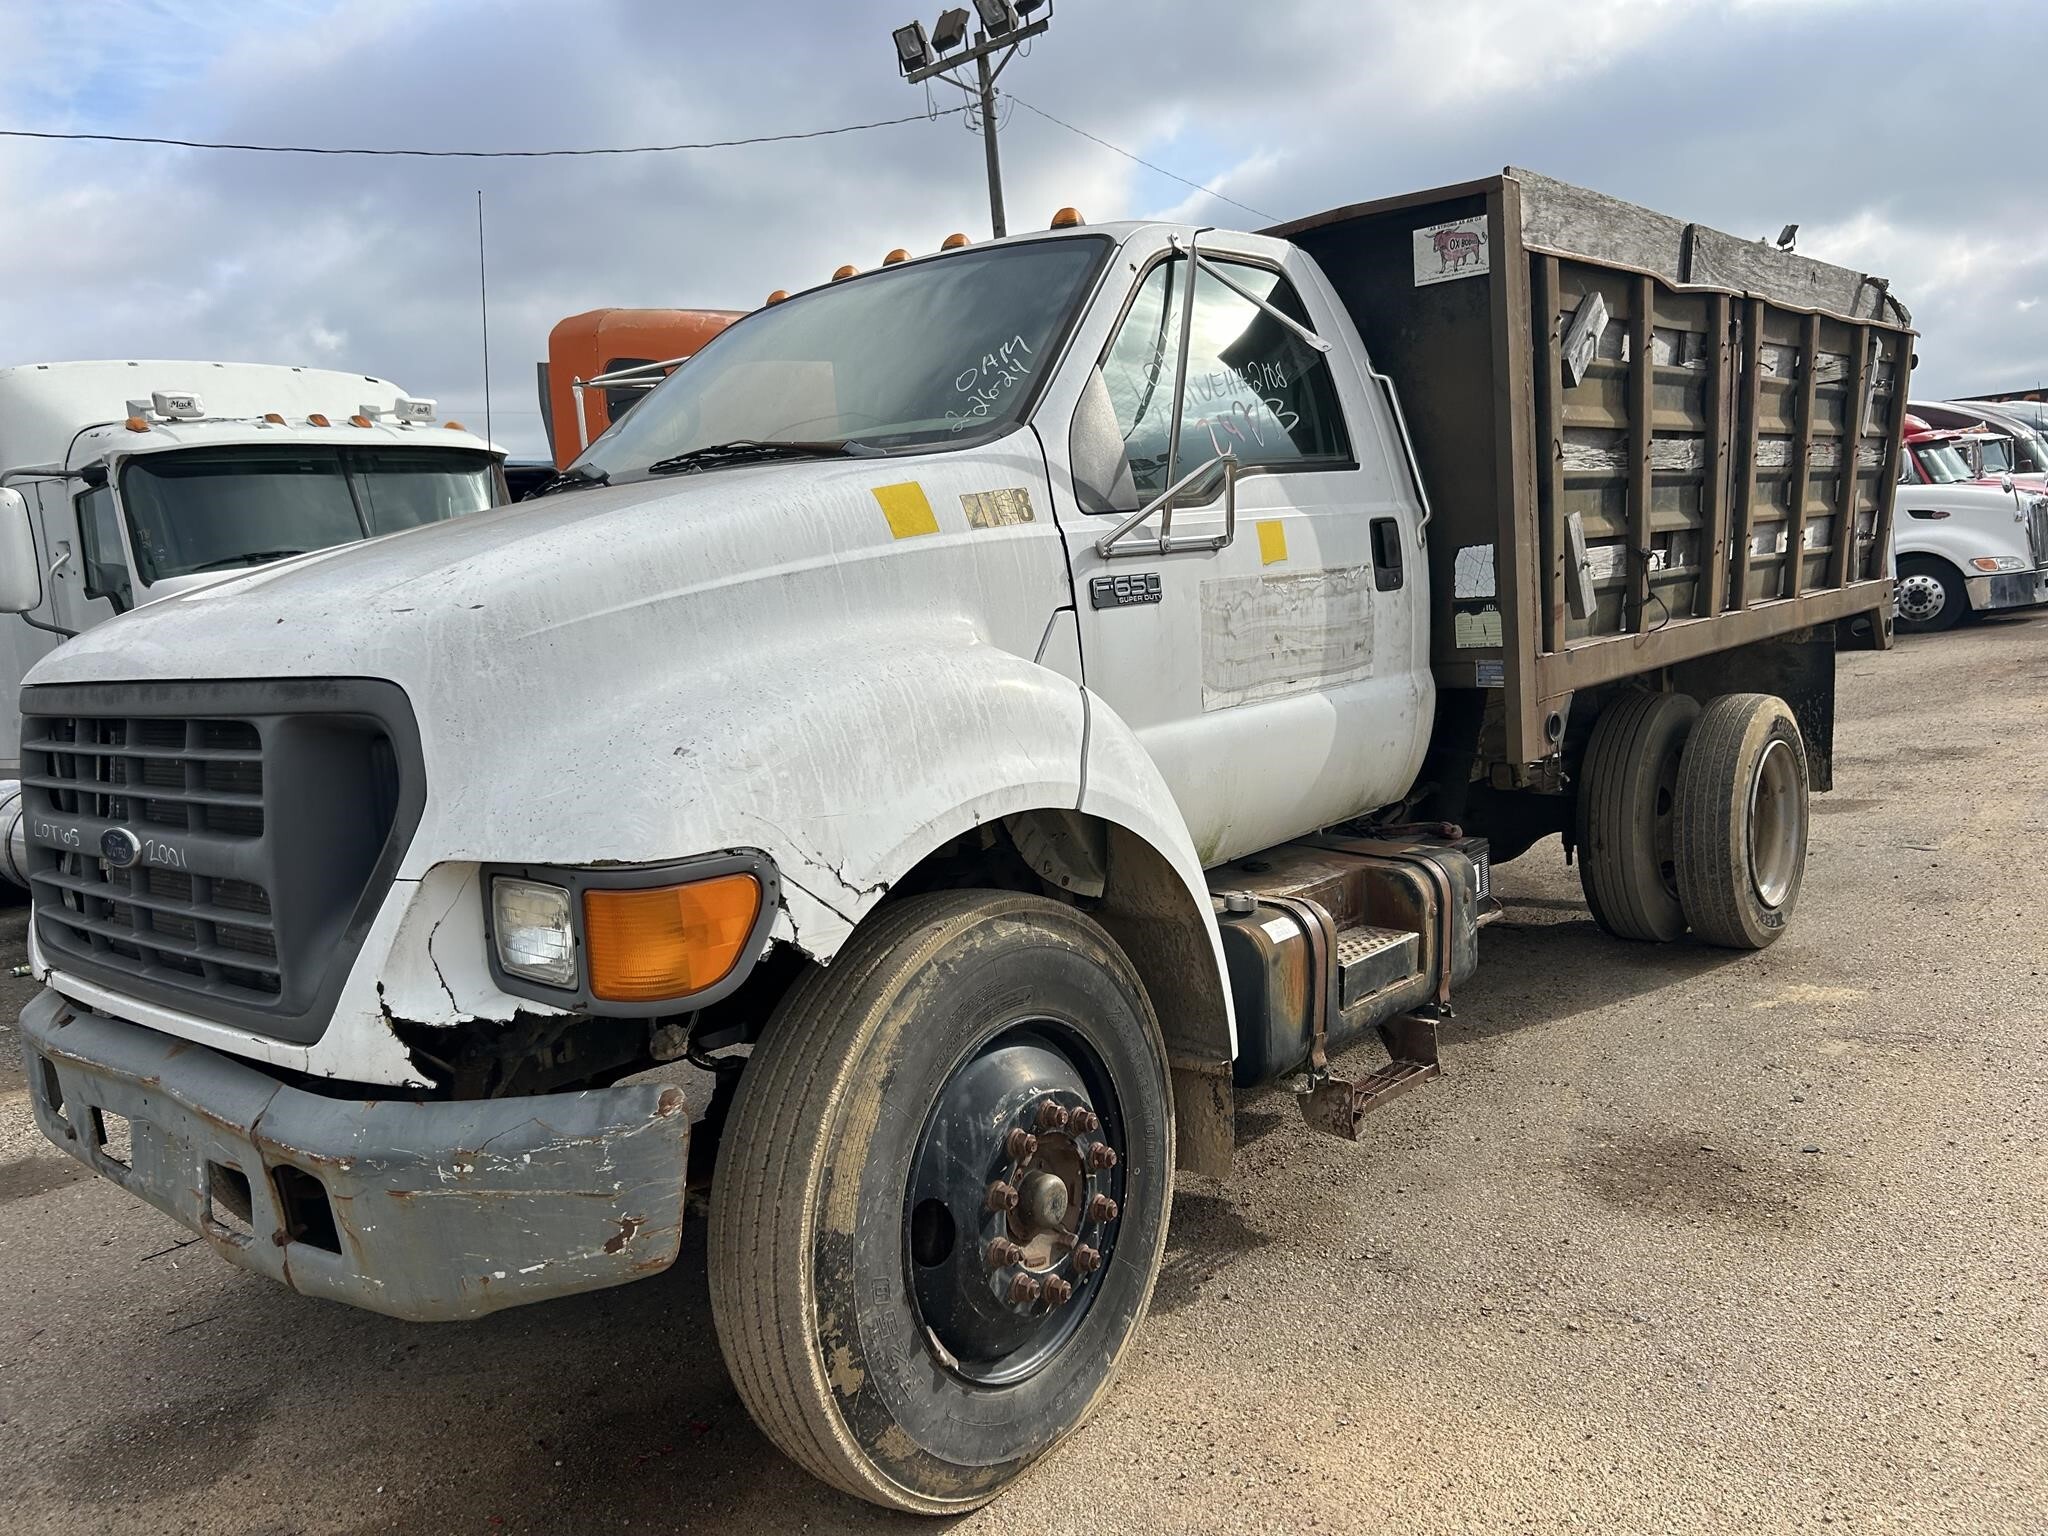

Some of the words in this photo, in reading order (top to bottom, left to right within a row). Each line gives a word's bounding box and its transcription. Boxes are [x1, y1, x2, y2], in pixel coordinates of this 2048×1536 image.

[1449, 238, 1460, 250] OX
[170, 400, 193, 410] Mack
[1093, 573, 1161, 599] F-650
[1119, 595, 1143, 604] SUPER
[1144, 593, 1162, 601] DUTY
[145, 839, 188, 869] 2001
